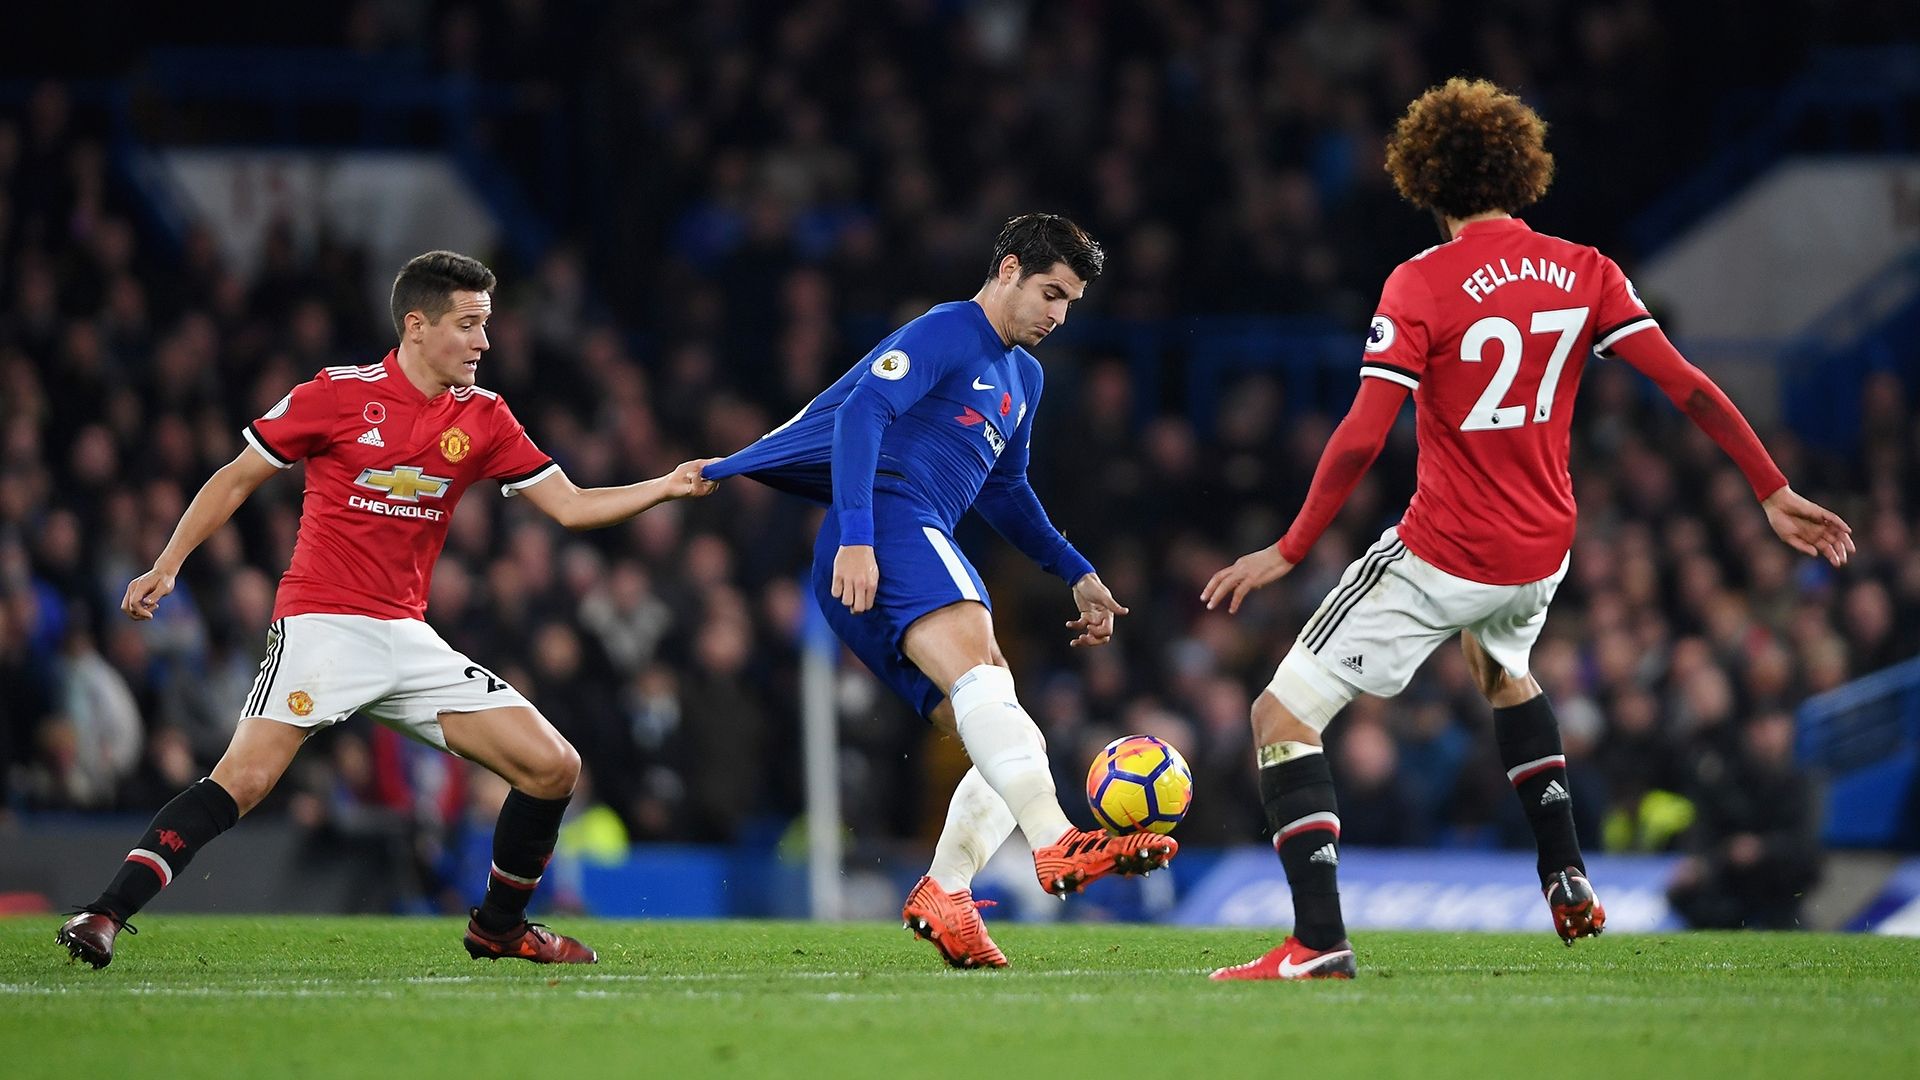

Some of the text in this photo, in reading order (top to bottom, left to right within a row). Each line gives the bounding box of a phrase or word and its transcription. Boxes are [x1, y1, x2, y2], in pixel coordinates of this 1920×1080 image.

[1461, 257, 1576, 304] FELLAINI
[1459, 306, 1590, 431] 27
[357, 436, 385, 448] adidas
[983, 420, 1006, 458] YOKOH
[348, 495, 444, 521] CHEVROLET
[463, 666, 508, 694] 2
